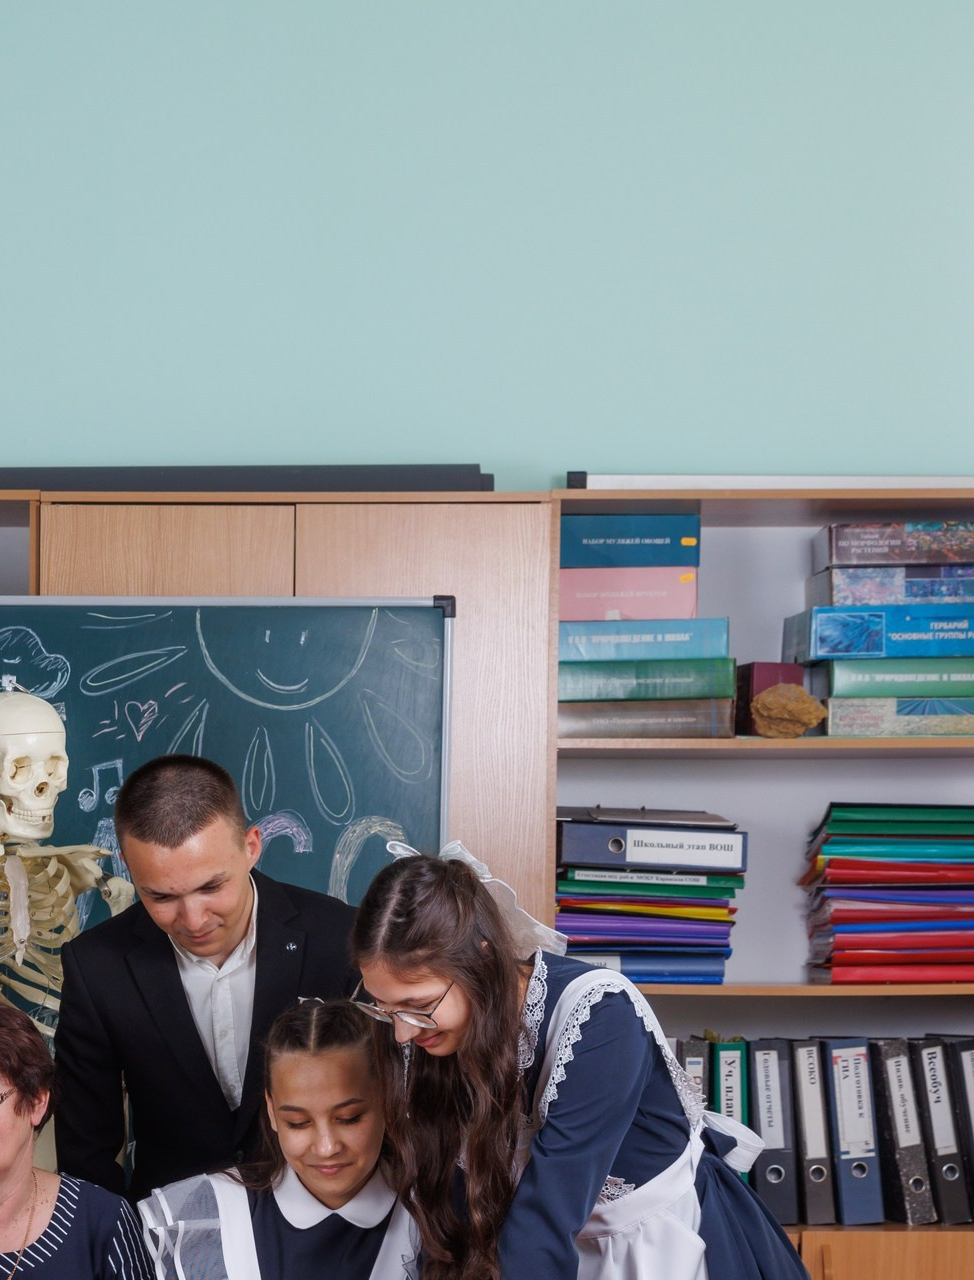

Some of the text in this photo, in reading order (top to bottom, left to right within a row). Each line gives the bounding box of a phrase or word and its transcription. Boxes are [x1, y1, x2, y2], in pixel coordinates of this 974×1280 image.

[930, 619, 969, 630] ГЕРБАРИЙ
[633, 839, 734, 852] Школьный этап ВОШ
[806, 1049, 817, 1085] ВСОКО
[841, 1059, 850, 1080] ГИА
[853, 1057, 864, 1110] Подготовка
[926, 1051, 943, 1104] Всеобуч
[762, 1052, 774, 1128] Годовые отчеты
[899, 1093, 911, 1134] обучение
